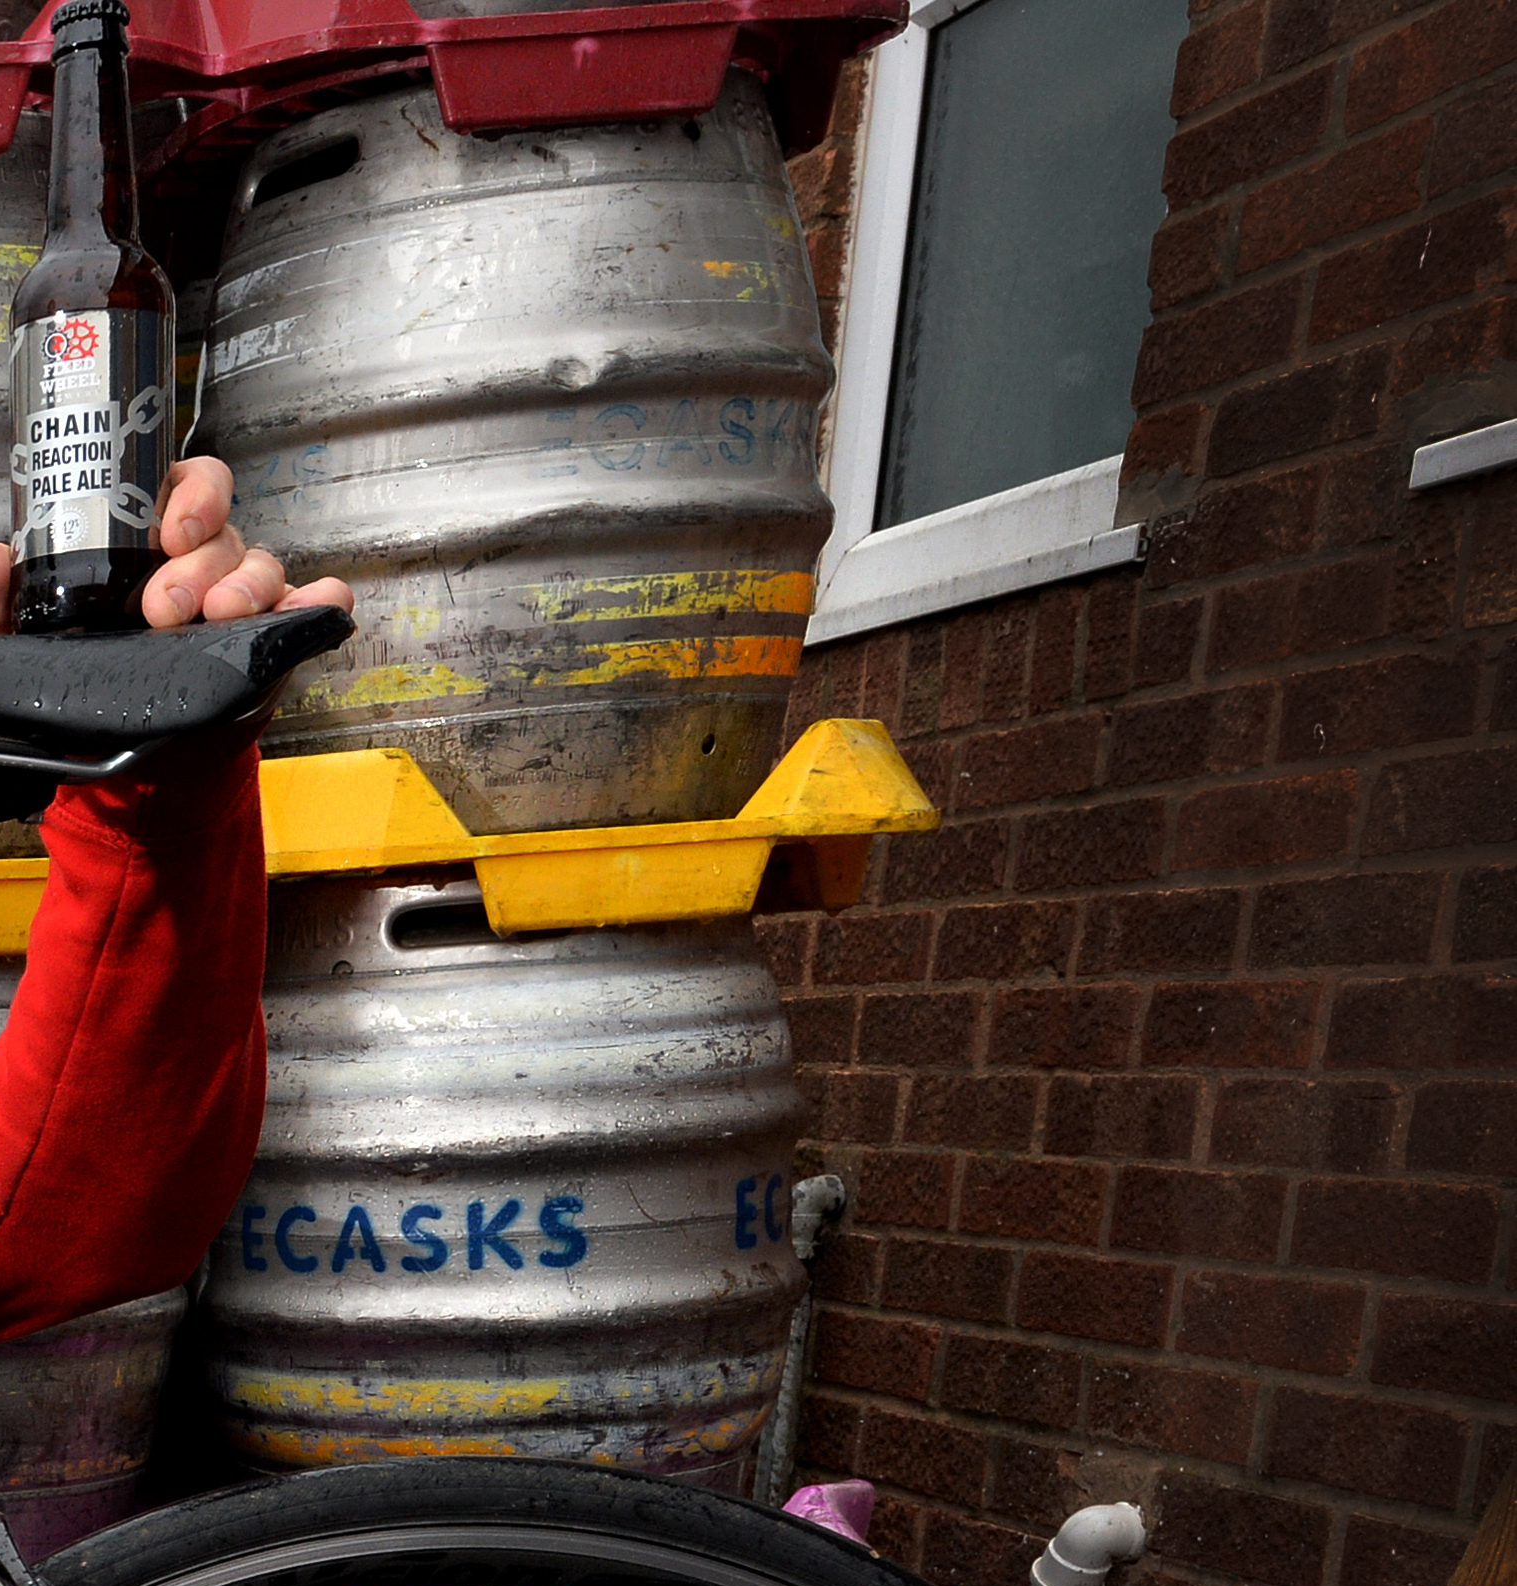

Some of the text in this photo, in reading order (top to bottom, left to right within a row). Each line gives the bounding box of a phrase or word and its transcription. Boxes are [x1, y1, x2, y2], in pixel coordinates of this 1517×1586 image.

[39, 374, 102, 395] WHEEL
[30, 409, 111, 444] CHAIN
[32, 441, 112, 472] REACTION
[32, 467, 112, 500] PALE ALE
[240, 1195, 589, 1274] ECASKS
